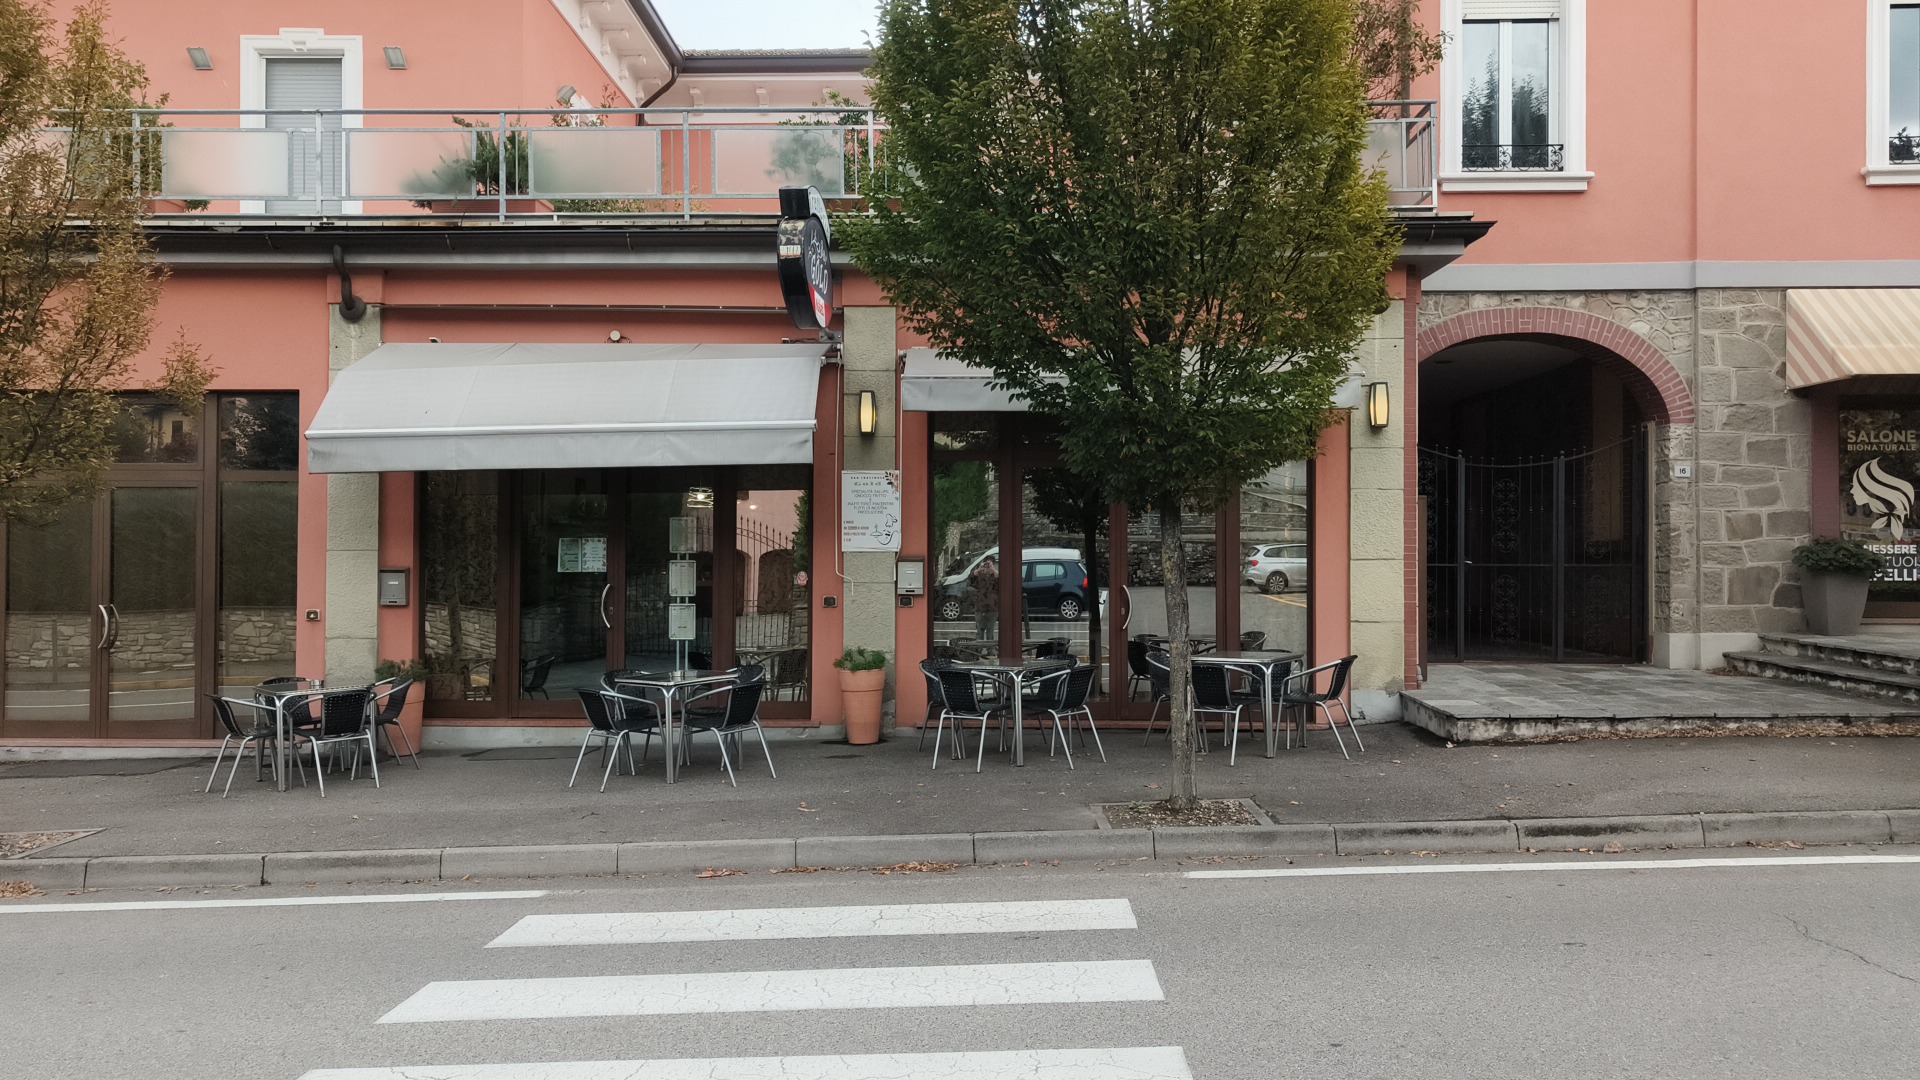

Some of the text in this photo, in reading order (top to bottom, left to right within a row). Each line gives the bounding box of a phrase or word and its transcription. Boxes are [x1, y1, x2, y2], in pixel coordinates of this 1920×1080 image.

[811, 254, 828, 294] GOLD
[1847, 430, 1917, 443] SALONE
[1679, 467, 1687, 475] 16
[1863, 544, 1918, 555] NESSERE
